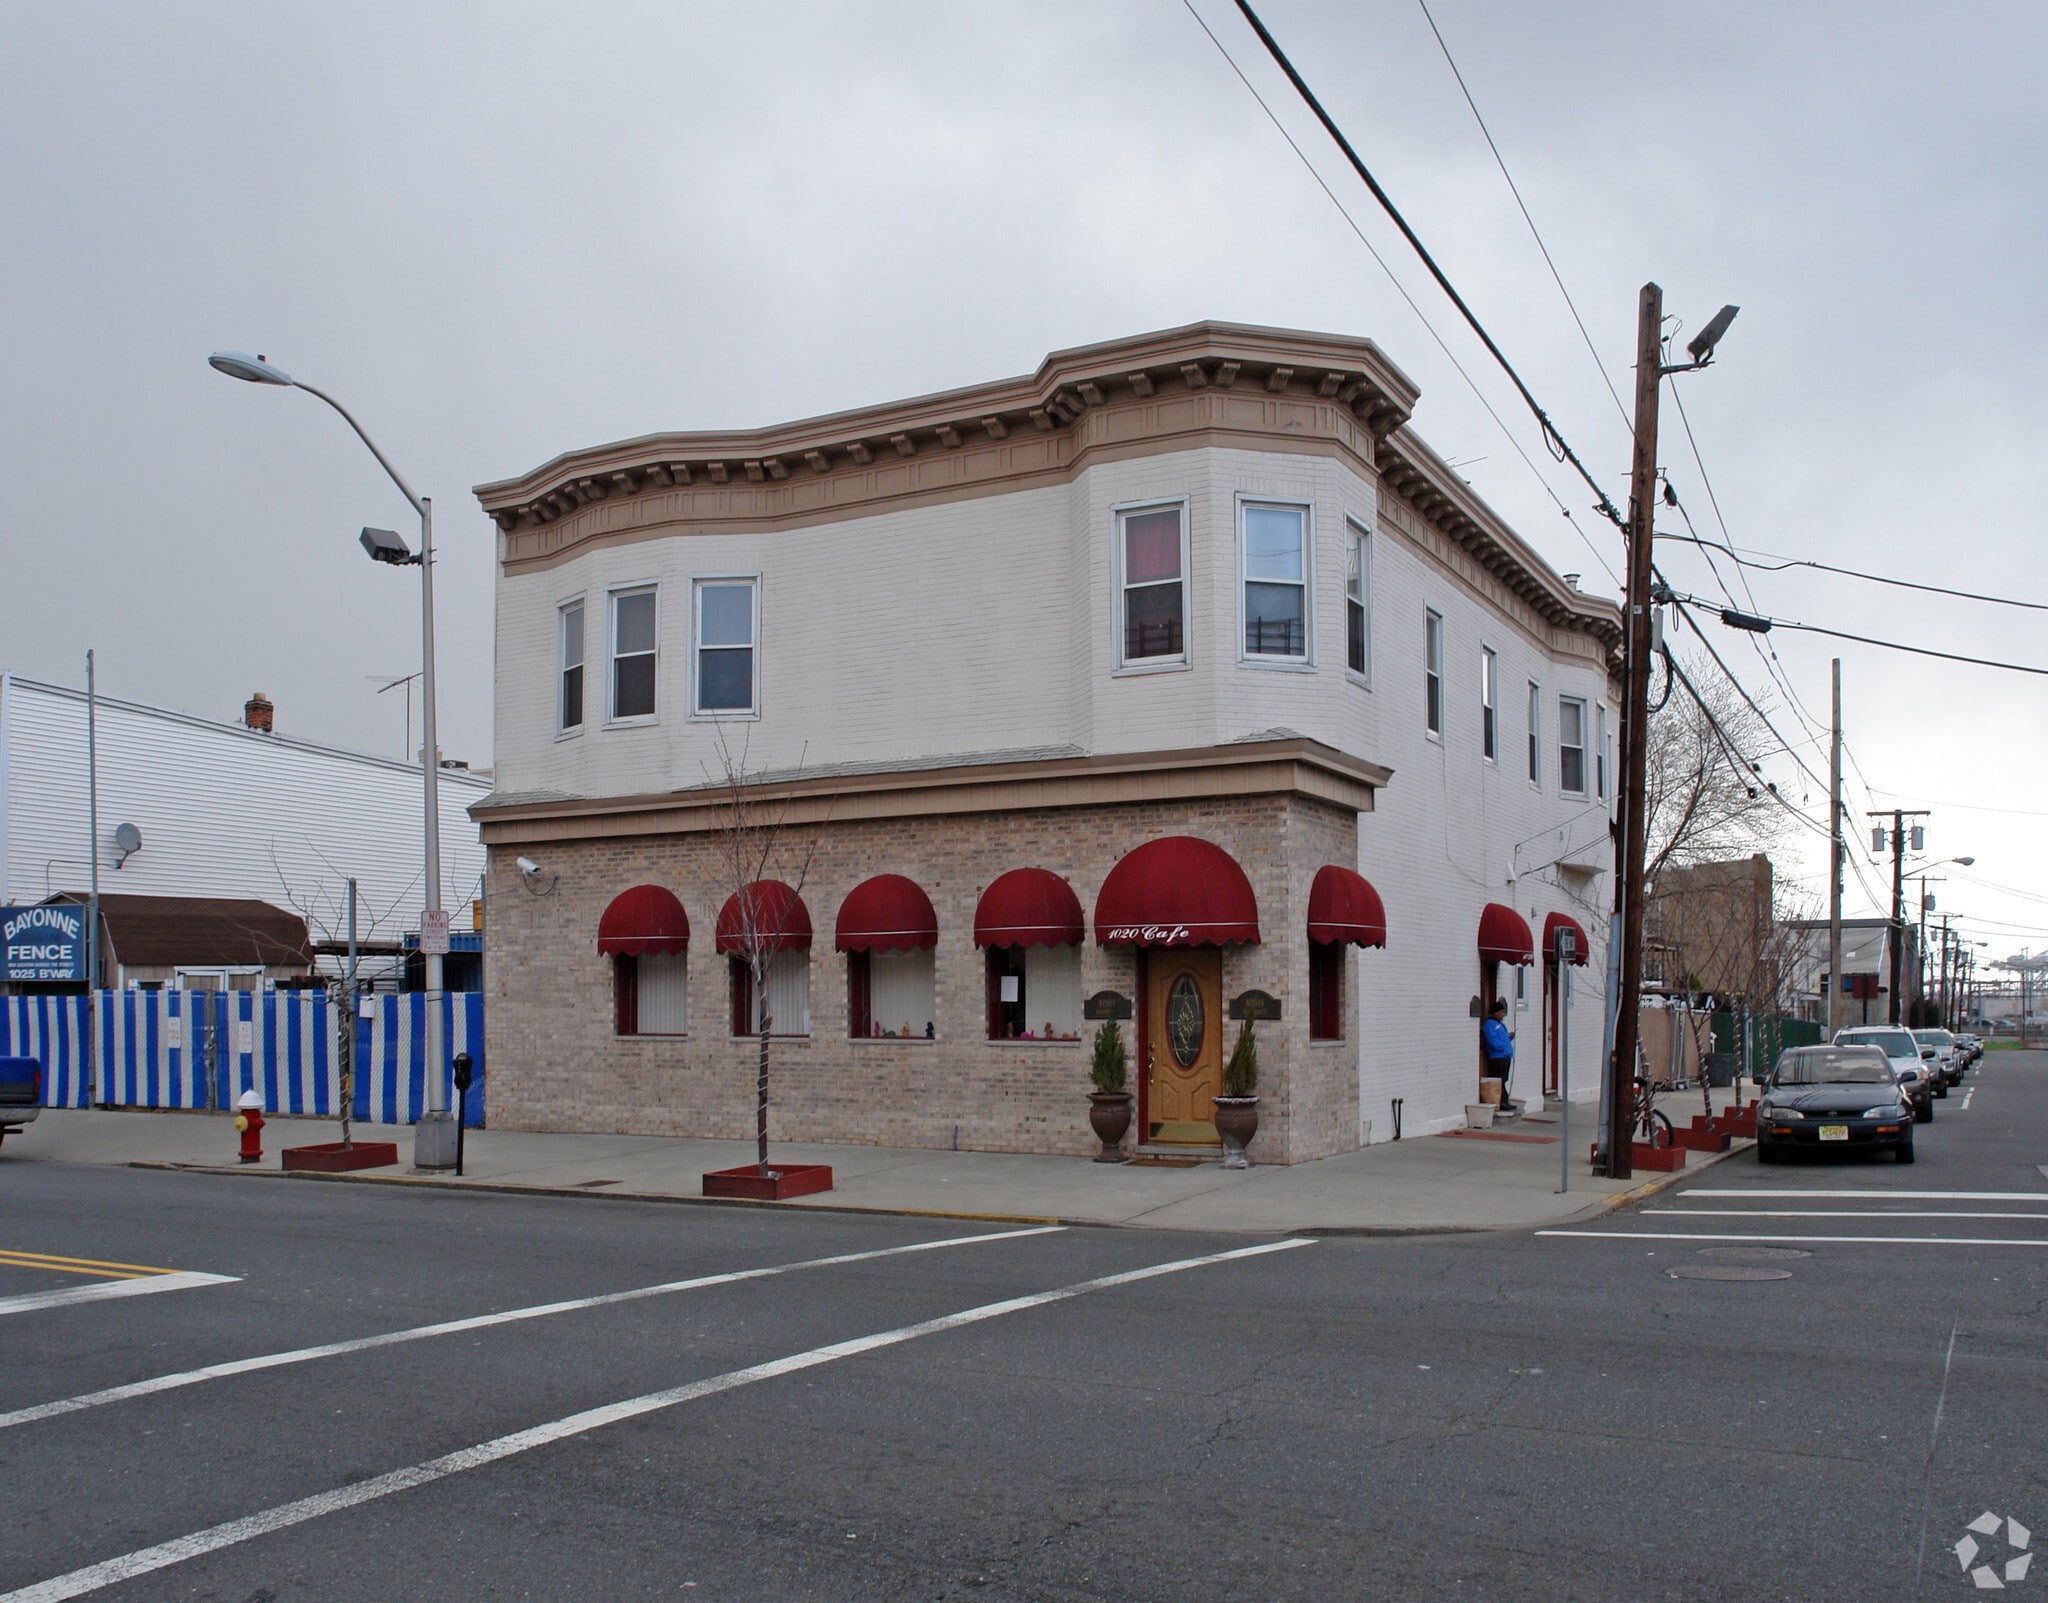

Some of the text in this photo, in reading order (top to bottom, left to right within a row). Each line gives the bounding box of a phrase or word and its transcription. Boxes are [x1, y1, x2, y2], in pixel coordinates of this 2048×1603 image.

[429, 912, 441, 921] NO
[4, 908, 80, 941] BAYONNE
[1108, 926, 1190, 943] 1020 Cafe
[7, 945, 73, 960] FENCE
[8, 969, 36, 978] 1025
